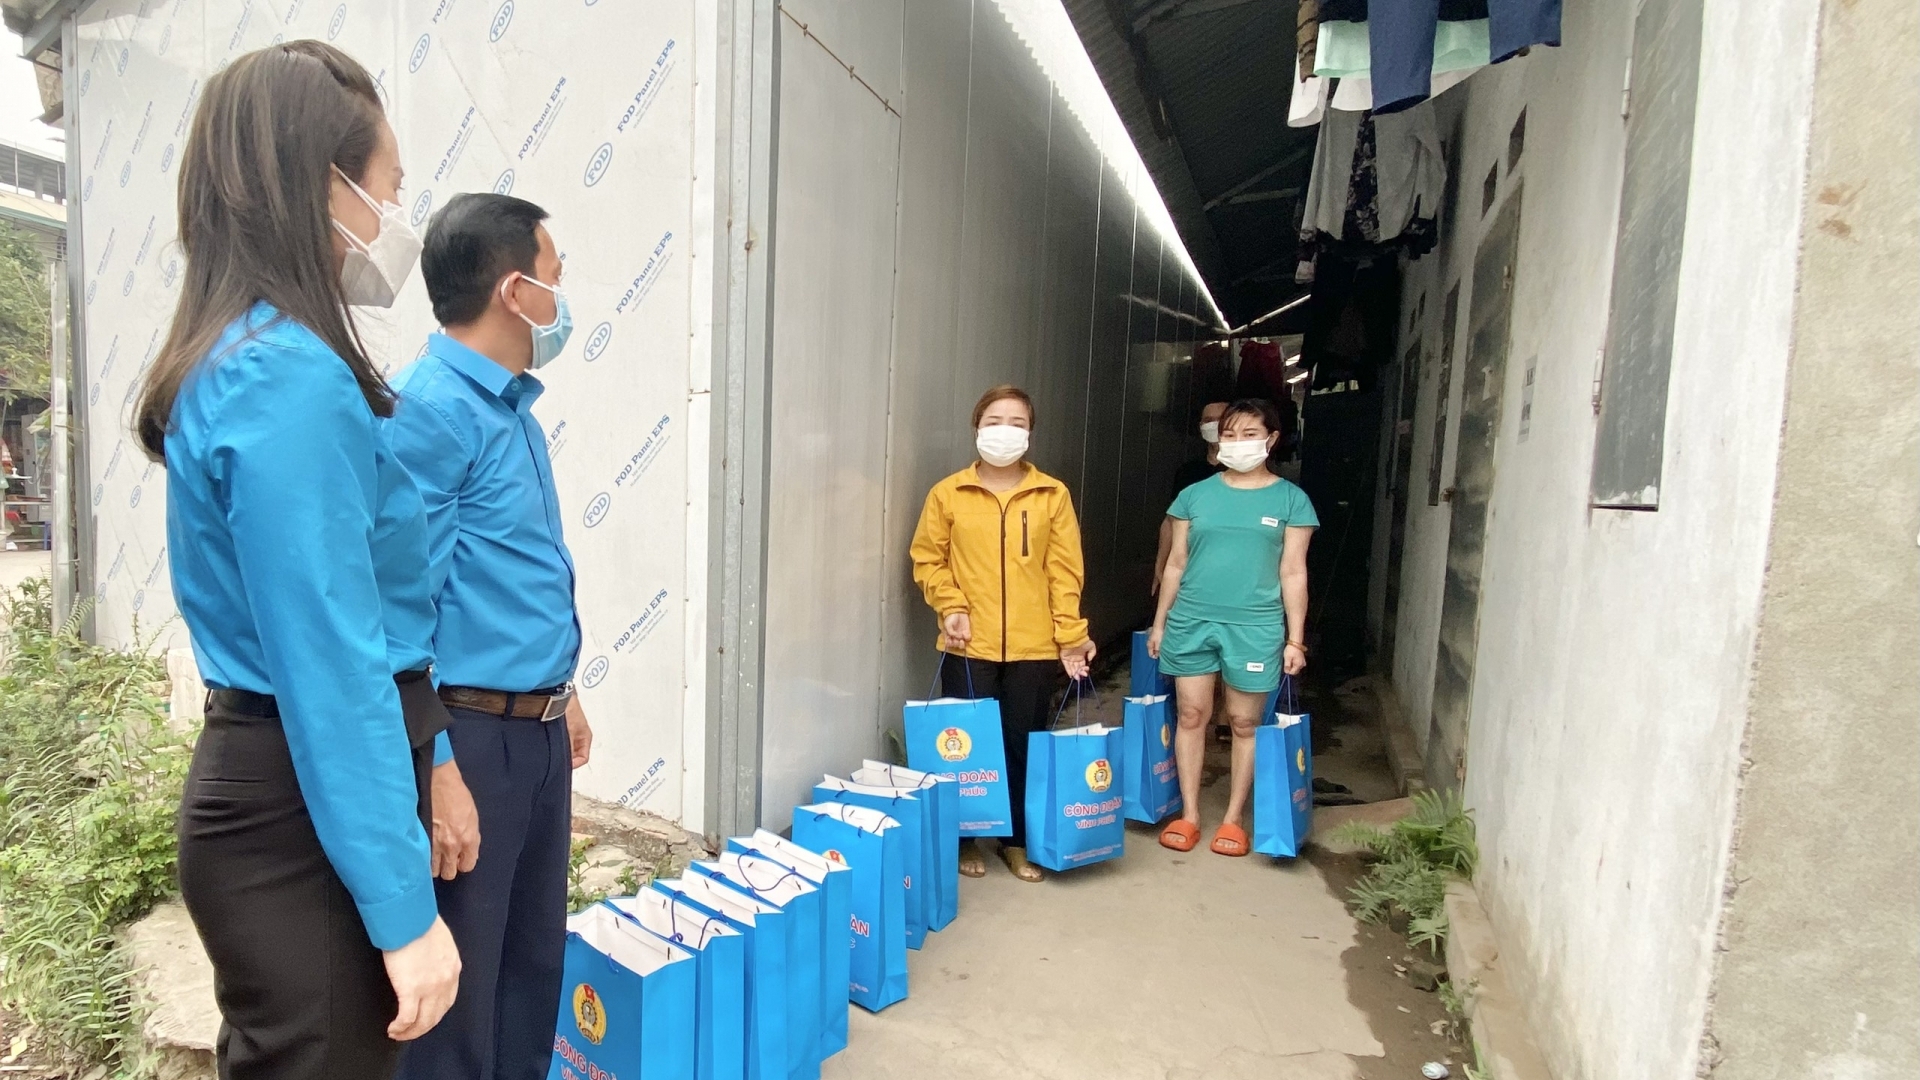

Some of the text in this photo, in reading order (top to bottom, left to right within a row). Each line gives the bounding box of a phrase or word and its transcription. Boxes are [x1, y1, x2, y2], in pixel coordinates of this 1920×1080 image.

[492, 5, 512, 37] FOD
[411, 38, 428, 69] FOD
[617, 105, 636, 134] FOD
[635, 69, 657, 104] Panel
[655, 38, 676, 68] EPS
[518, 135, 533, 161] FOD
[532, 103, 552, 134] Panel
[550, 76, 567, 102] EPS
[434, 159, 447, 182] FOD
[446, 131, 463, 159] Panel
[461, 106, 475, 130] EPS
[587, 146, 610, 181] FOD
[496, 172, 513, 195] OD
[413, 193, 430, 223] FOD
[615, 289, 635, 315] FOD
[633, 258, 655, 289] Panel
[653, 231, 674, 258] EPS
[586, 327, 609, 358] FOD
[551, 419, 567, 440] EPS
[615, 464, 632, 487] FOD
[631, 436, 653, 466] Panel
[652, 414, 671, 438] EPS
[586, 496, 608, 524] FOD
[612, 631, 631, 653] FOD
[629, 607, 652, 634] Panel
[649, 588, 668, 610] EPS
[585, 660, 606, 685] FOD
[627, 774, 649, 797] Panel
[647, 757, 666, 777] EPS
[959, 768, 999, 784] ĐOÀN
[959, 785, 988, 797] PHÚC
[1064, 801, 1099, 817] CÔNG
